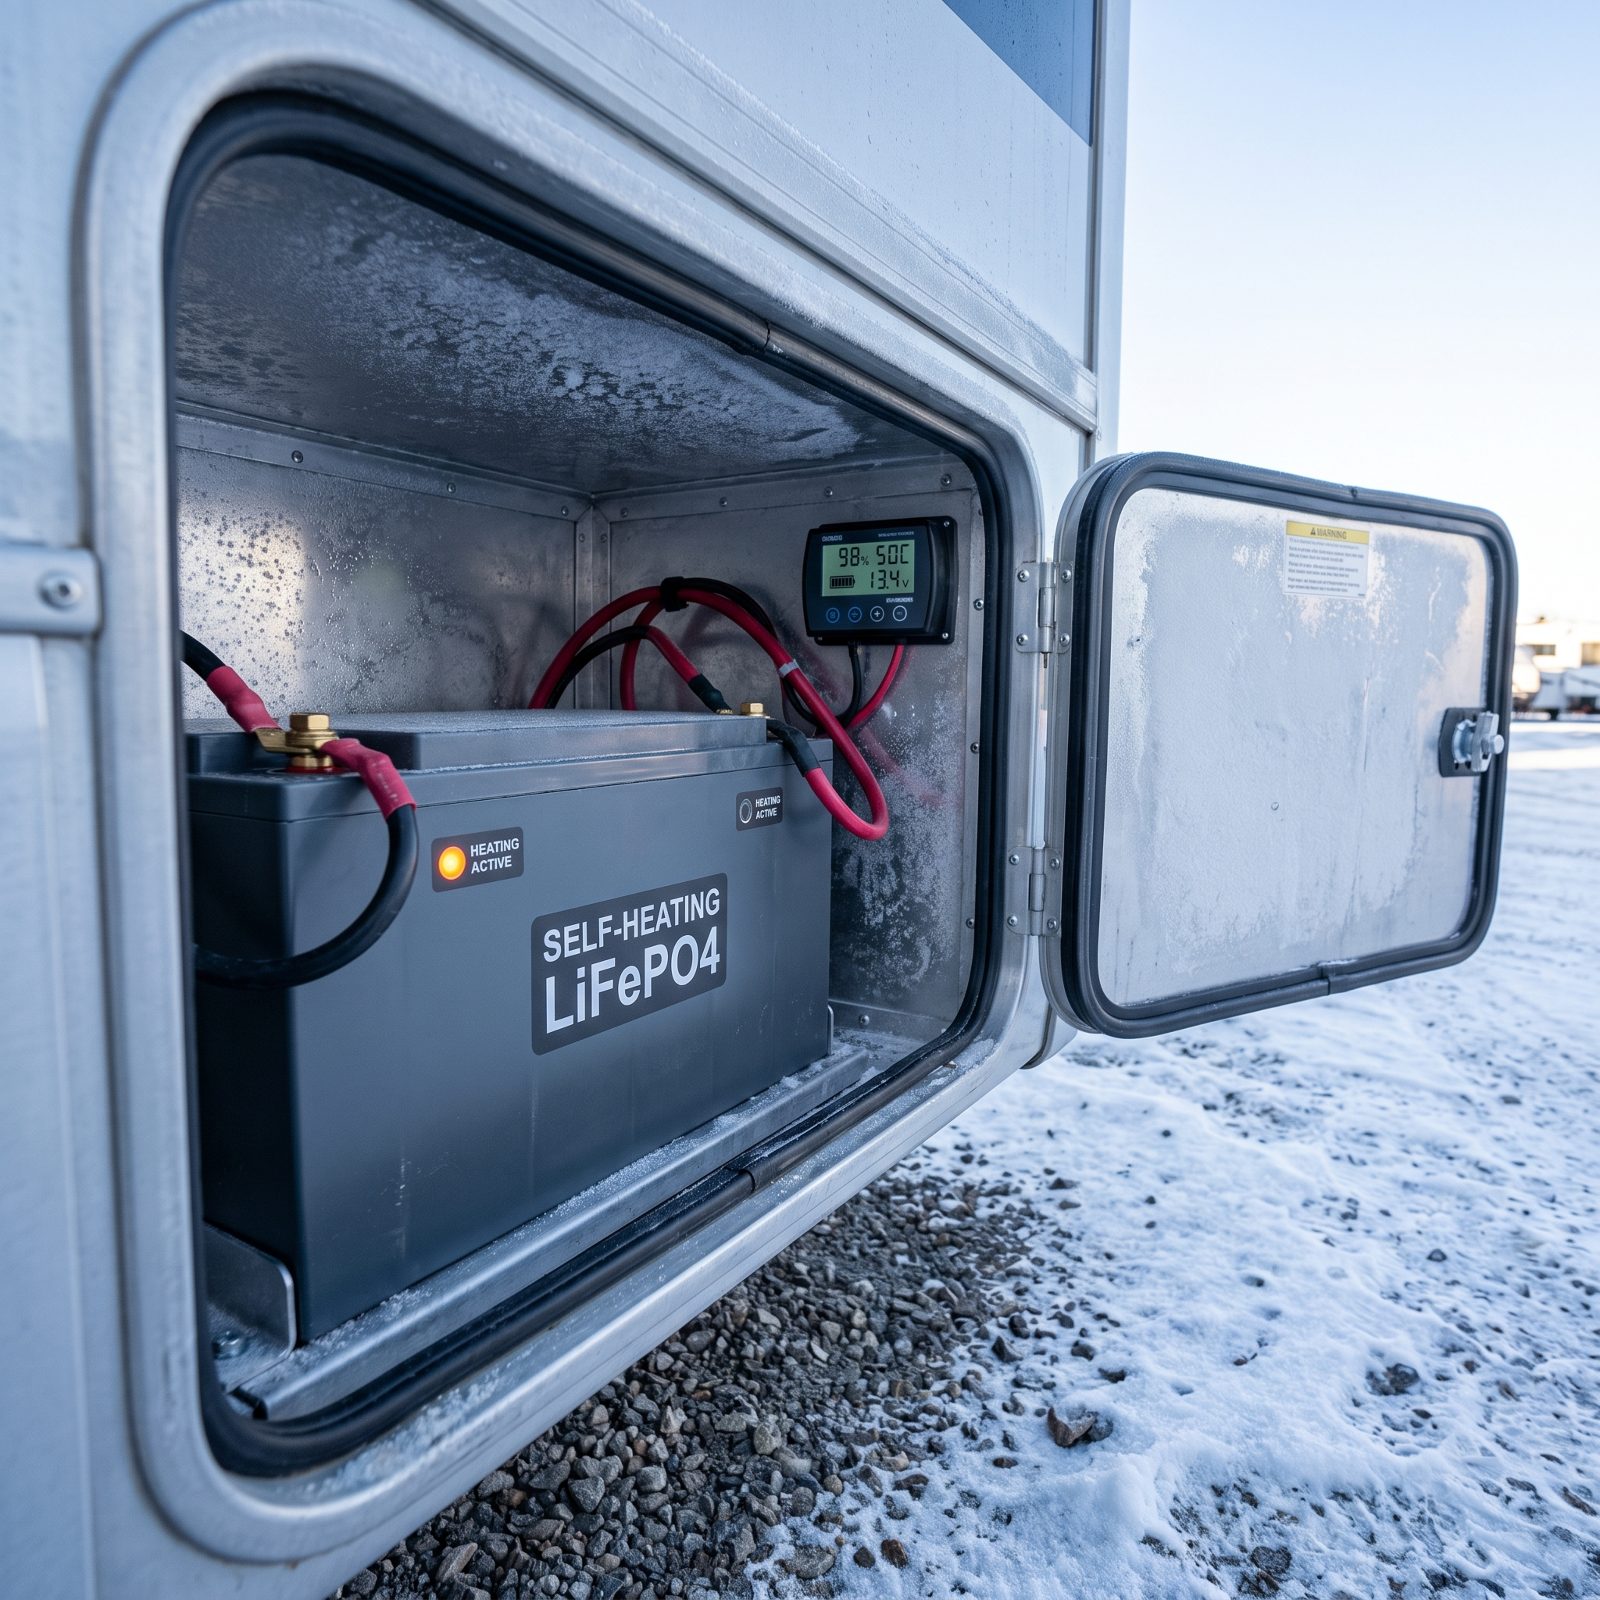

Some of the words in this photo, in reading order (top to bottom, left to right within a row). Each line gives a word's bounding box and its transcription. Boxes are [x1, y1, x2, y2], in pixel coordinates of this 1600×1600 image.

[1316, 528, 1347, 540] WARNING
[755, 796, 781, 811] HEATING
[755, 807, 777, 824] ACTIVE
[470, 838, 520, 857] HEATING
[471, 855, 513, 875] ACTIVE
[543, 888, 720, 963] SELF-HEATING
[545, 926, 720, 1034] LiFePO4
